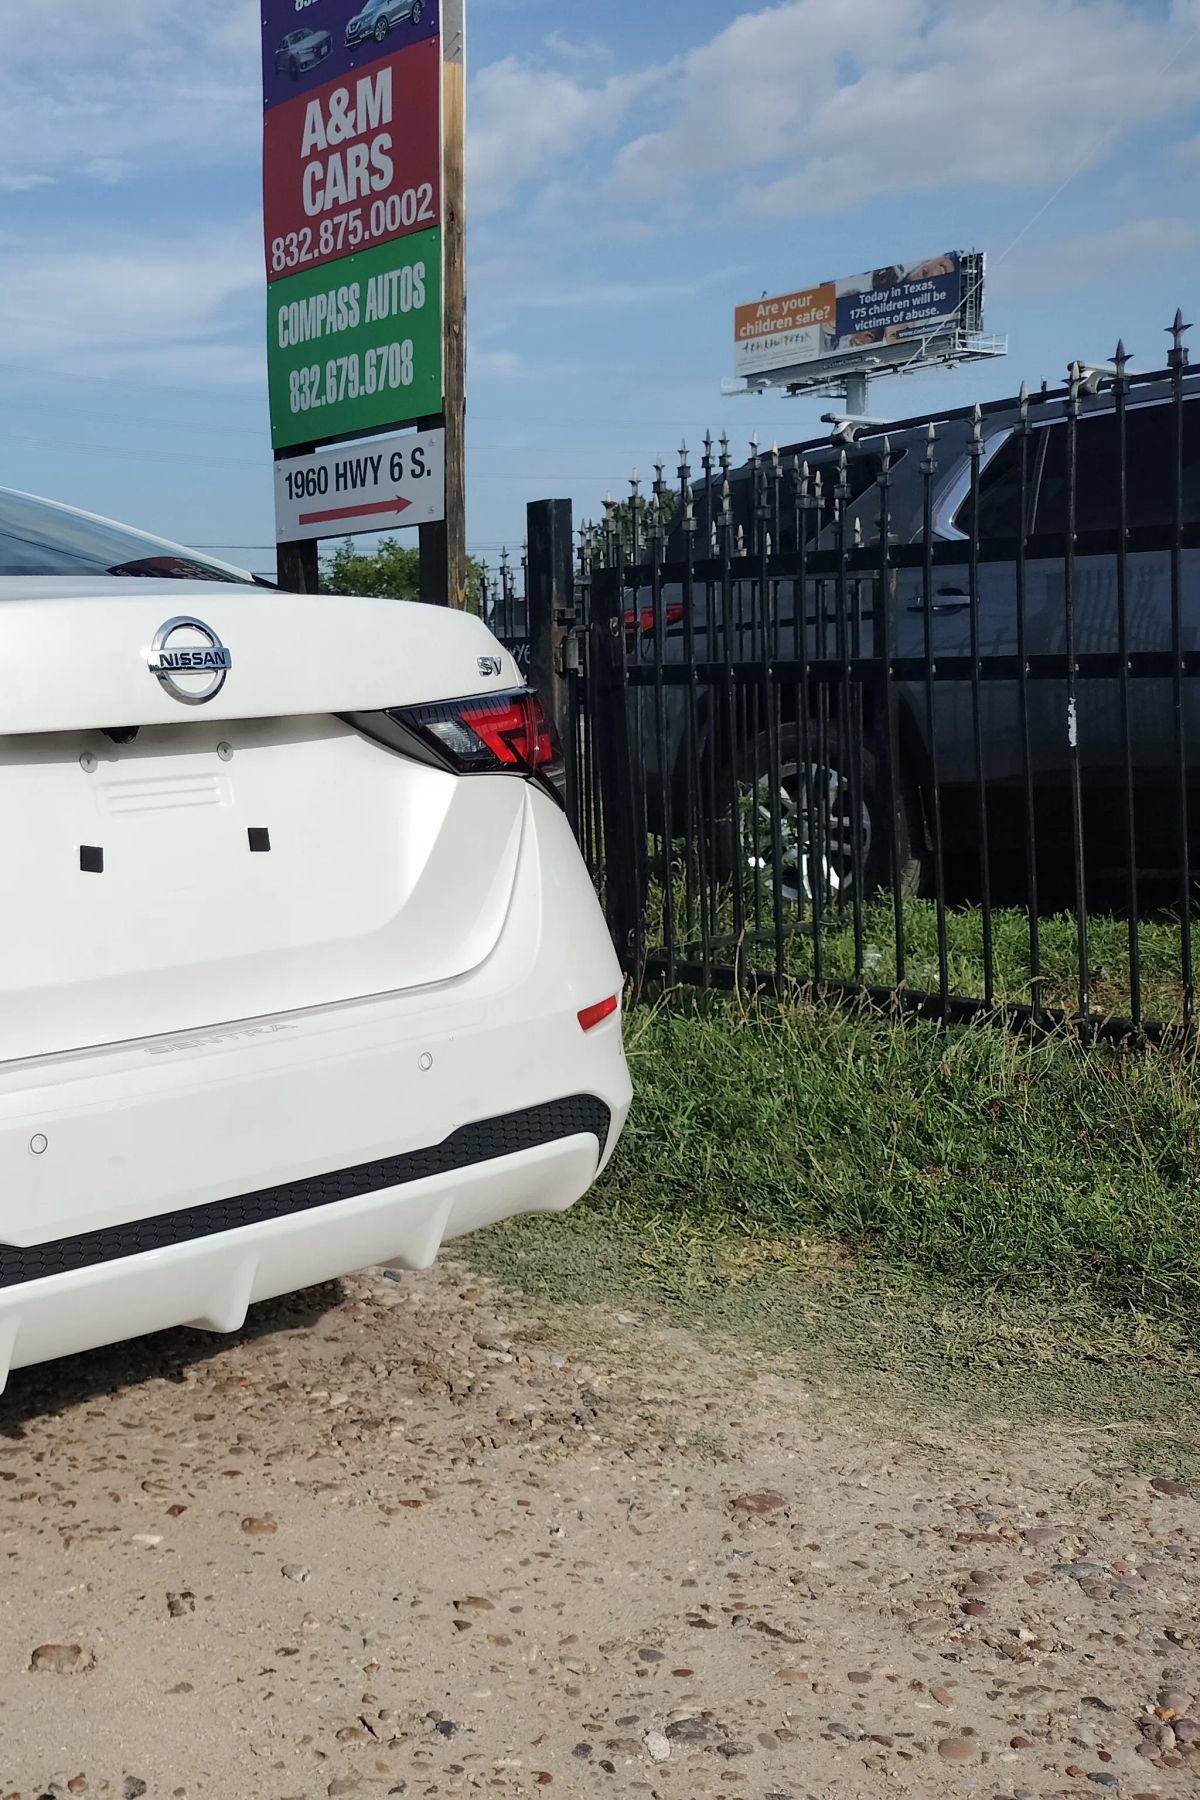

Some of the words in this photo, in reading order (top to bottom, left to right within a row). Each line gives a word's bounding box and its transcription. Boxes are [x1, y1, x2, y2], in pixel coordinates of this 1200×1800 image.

[300, 66, 392, 158] A&M
[302, 132, 394, 216] CARS
[271, 182, 434, 272] 832.875.0002
[278, 282, 360, 349] COMPASS
[365, 261, 426, 323] AUTOS
[756, 304, 779, 318] Are
[782, 295, 813, 315] your
[850, 309, 867, 319] 175
[868, 299, 910, 315] children
[912, 292, 931, 306] will
[933, 290, 947, 301] be
[859, 289, 890, 305] Today
[891, 287, 901, 297] in
[904, 281, 936, 295] Texas,
[740, 316, 812, 337] children
[795, 306, 831, 325] safe?
[855, 315, 891, 331] victims
[893, 312, 904, 324] of
[905, 306, 940, 320] abuse.
[289, 338, 414, 414] 832.679.6708
[285, 465, 328, 500] 1960
[335, 454, 382, 492] HWY
[389, 451, 403, 482] 6
[410, 446, 432, 479] S.
[159, 652, 226, 667] NISSAN
[477, 656, 502, 677] SV
[143, 1022, 300, 1056] SENTRA
